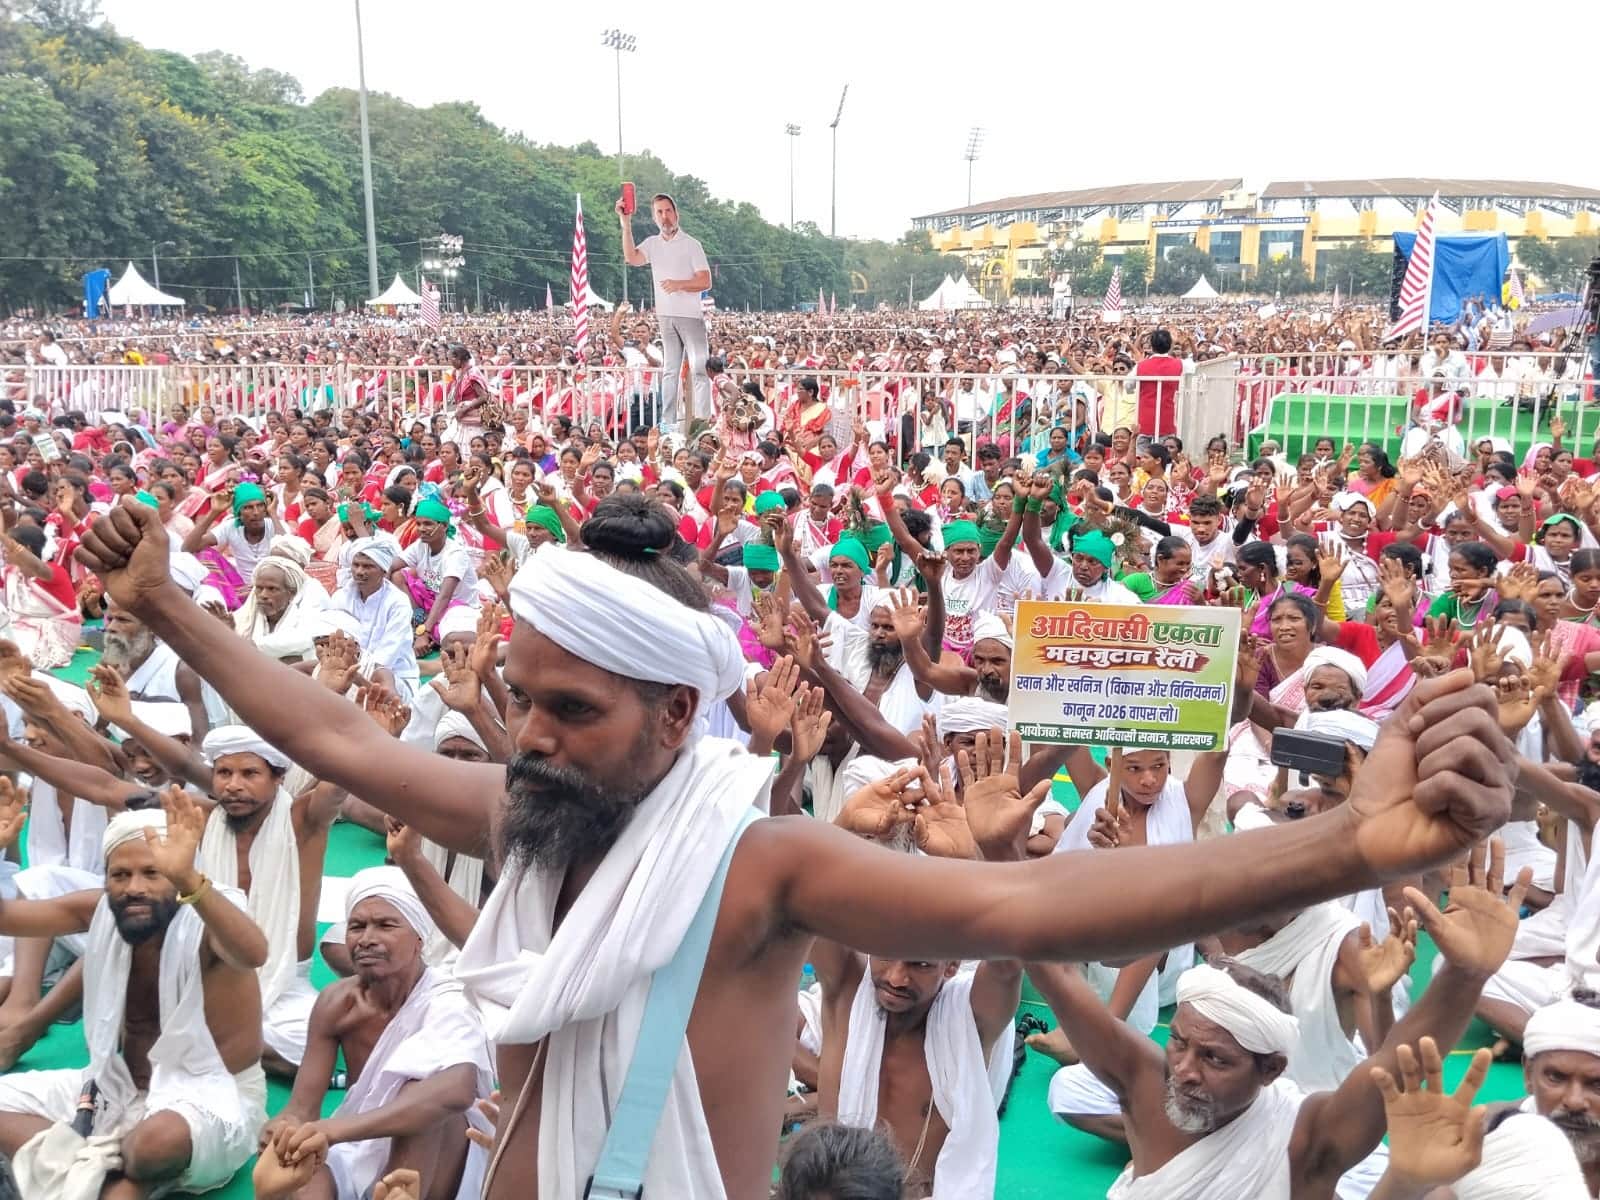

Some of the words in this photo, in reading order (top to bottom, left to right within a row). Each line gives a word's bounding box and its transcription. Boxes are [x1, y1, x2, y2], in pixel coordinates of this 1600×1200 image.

[1031, 609, 1149, 641] आदिवासी
[1152, 622, 1223, 646] एकता
[1045, 646, 1152, 668] महाजुटान
[1155, 647, 1198, 669] रैली
[1016, 675, 1043, 691] खान
[1045, 673, 1065, 692] और
[1067, 675, 1103, 694] खनिज
[1105, 676, 1145, 697] (विकास
[1147, 679, 1168, 697] और
[1169, 680, 1226, 704] विनियमन)
[1063, 702, 1096, 722] कानून
[1098, 704, 1127, 720] 2026
[1128, 705, 1157, 721] वापस
[1019, 723, 1061, 738] आयोजक:
[1062, 727, 1094, 740] समस्त
[1094, 727, 1137, 743] आदिवासी
[1138, 731, 1170, 746] समाज,
[1171, 733, 1214, 747] झारखण्ड
